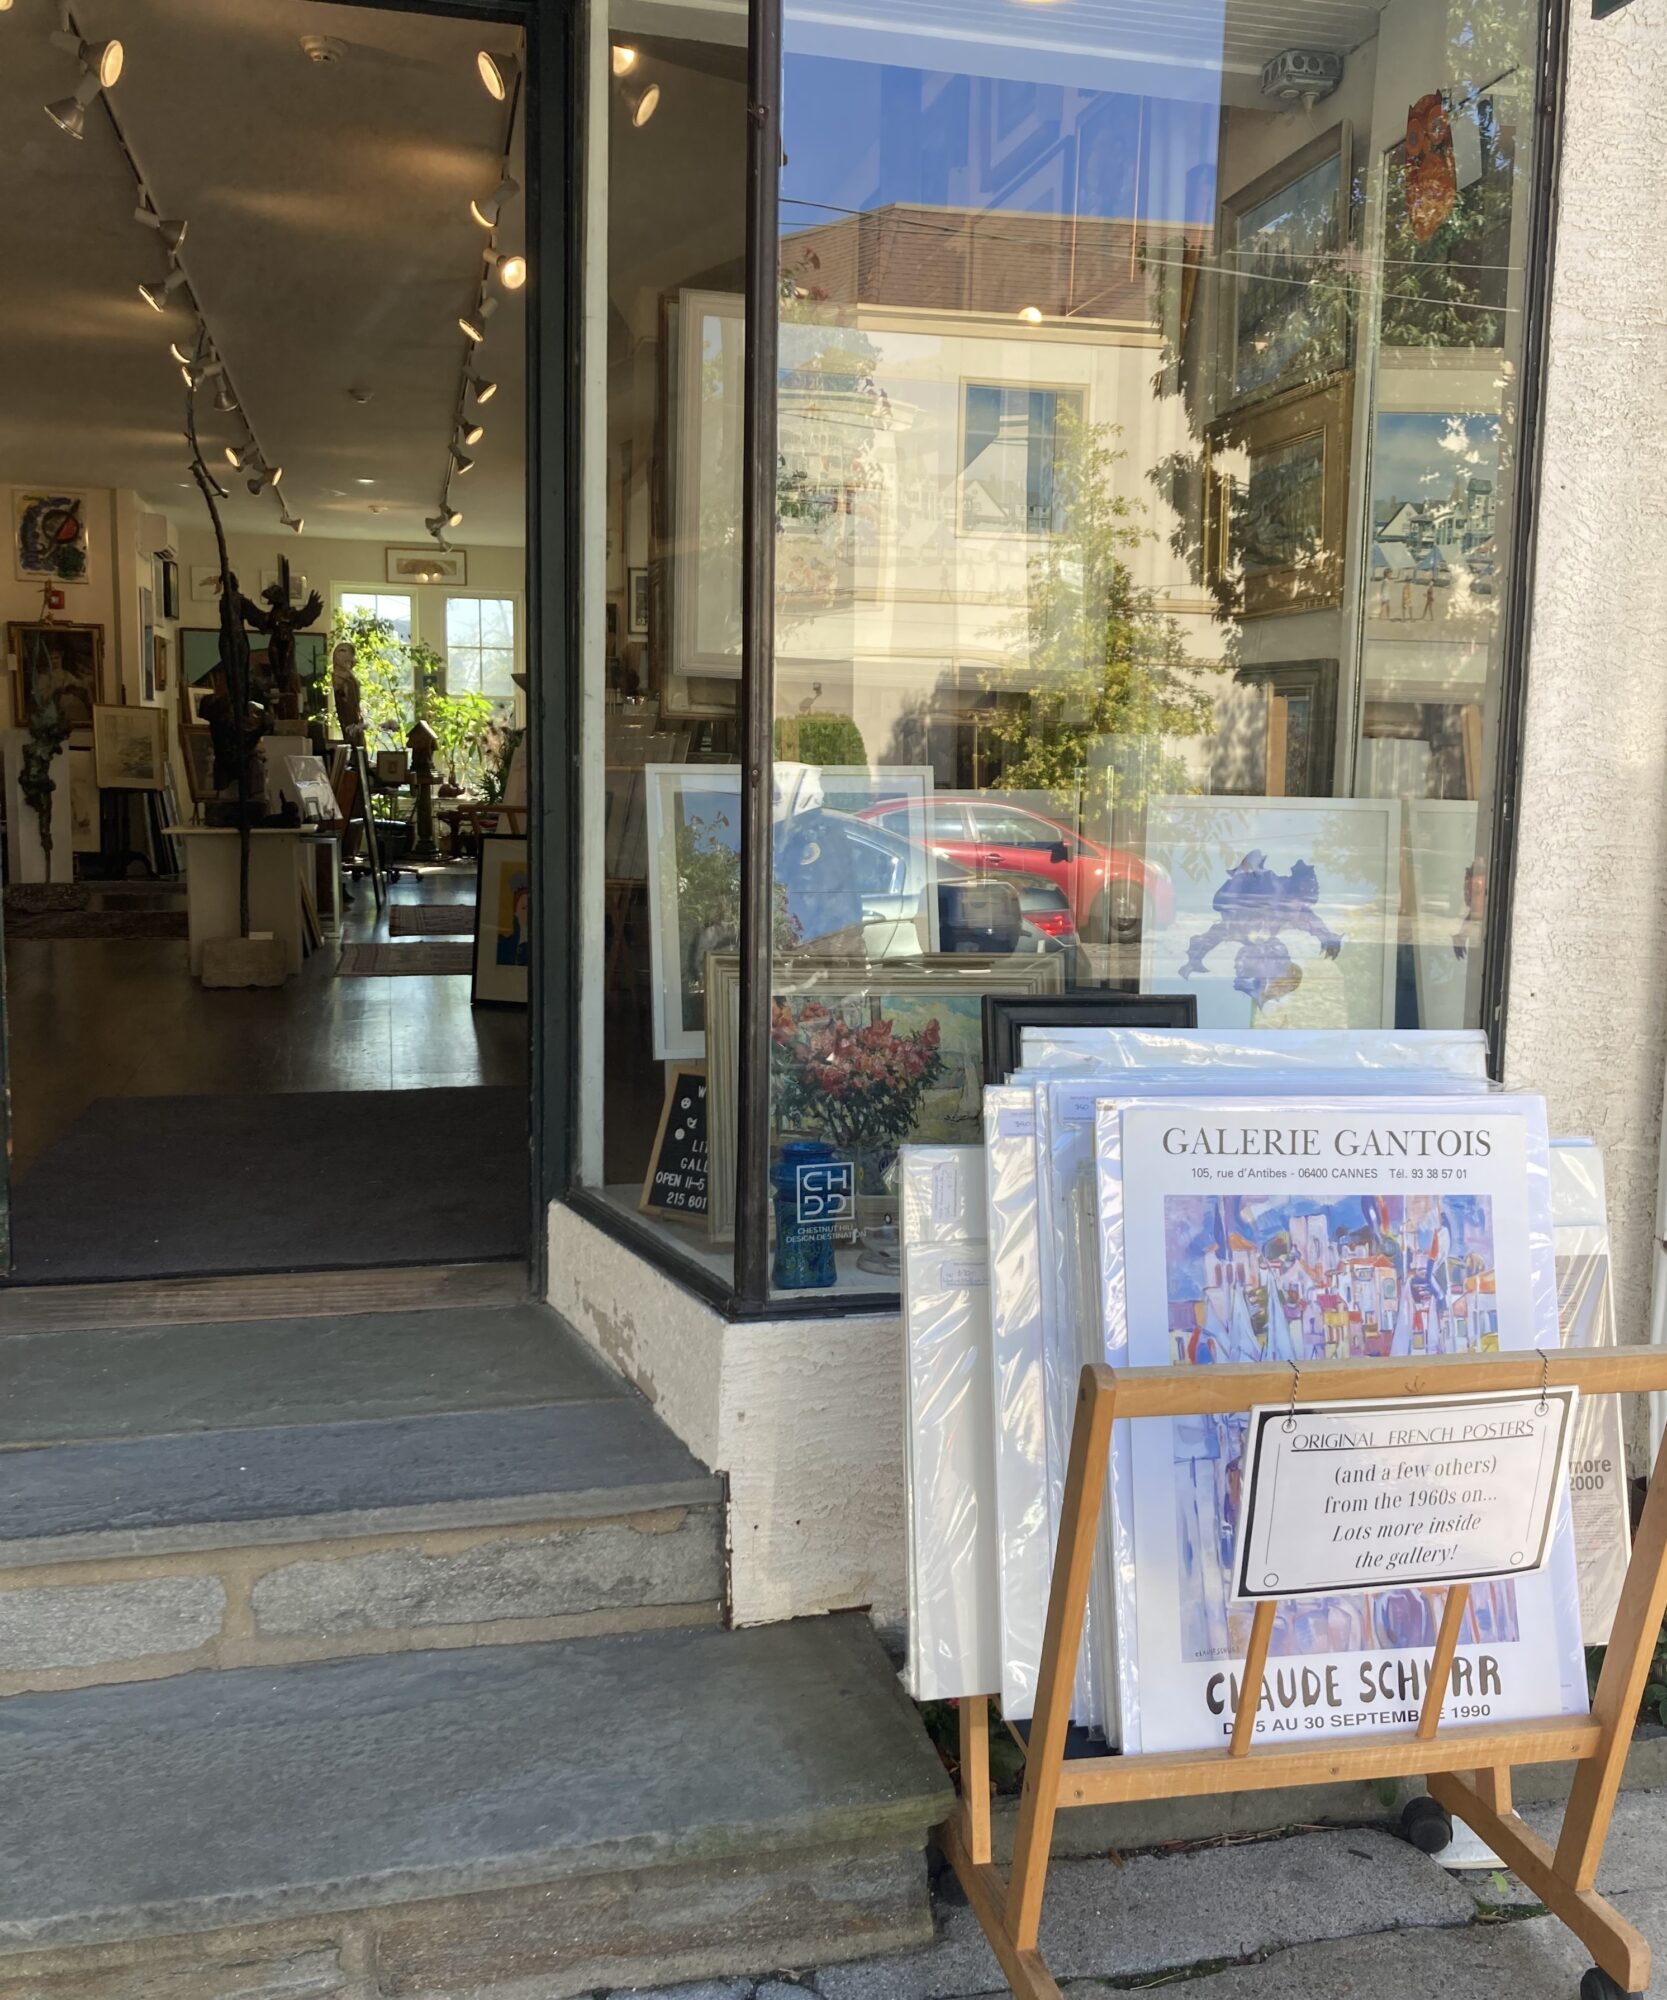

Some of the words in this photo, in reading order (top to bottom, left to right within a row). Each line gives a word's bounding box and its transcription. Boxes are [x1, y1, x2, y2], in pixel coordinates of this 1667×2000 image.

[1162, 1127, 1321, 1155] GALERIE
[1334, 1129, 1492, 1157] GANTOIS
[680, 1157, 709, 1173] GALL
[1191, 1168, 1213, 1179] 105,
[1217, 1169, 1234, 1178] rue
[1237, 1167, 1287, 1178] d'Antibes
[1298, 1168, 1328, 1178] 06400
[1331, 1168, 1378, 1178] CANNES
[1389, 1168, 1408, 1178] Tél.
[1411, 1168, 1424, 1178] 93
[1426, 1168, 1439, 1178] 38
[1441, 1168, 1453, 1178] 57
[1456, 1168, 1467, 1178] 01
[655, 1171, 682, 1187] OPEN
[803, 1169, 847, 1191] CH
[666, 1191, 686, 1206] 215
[786, 1234, 815, 1243] DESIGN
[816, 1231, 867, 1241] DESTINATON
[797, 1225, 838, 1235] CHESTNUT
[1292, 1432, 1375, 1450] ORIGINAL
[1388, 1427, 1453, 1446] FRENCH
[1463, 1419, 1535, 1440] POSTERS
[1335, 1463, 1376, 1486] (and
[1381, 1470, 1391, 1481] a
[1396, 1461, 1430, 1481] few
[1434, 1455, 1497, 1477] others)
[1324, 1495, 1368, 1514] from
[1374, 1491, 1402, 1509] the
[1408, 1488, 1456, 1508] 1960s
[1462, 1488, 1497, 1503] on...
[1332, 1525, 1374, 1542] Lots
[1377, 1521, 1423, 1538] more
[1428, 1513, 1481, 1534] inside
[1355, 1551, 1383, 1569] the
[1386, 1544, 1458, 1570] gallery!
[1272, 1719, 1298, 1732] AU
[1304, 1715, 1325, 1729] 30
[1330, 1708, 1446, 1728] SEPTEMB
[1451, 1704, 1491, 1720] 1990
